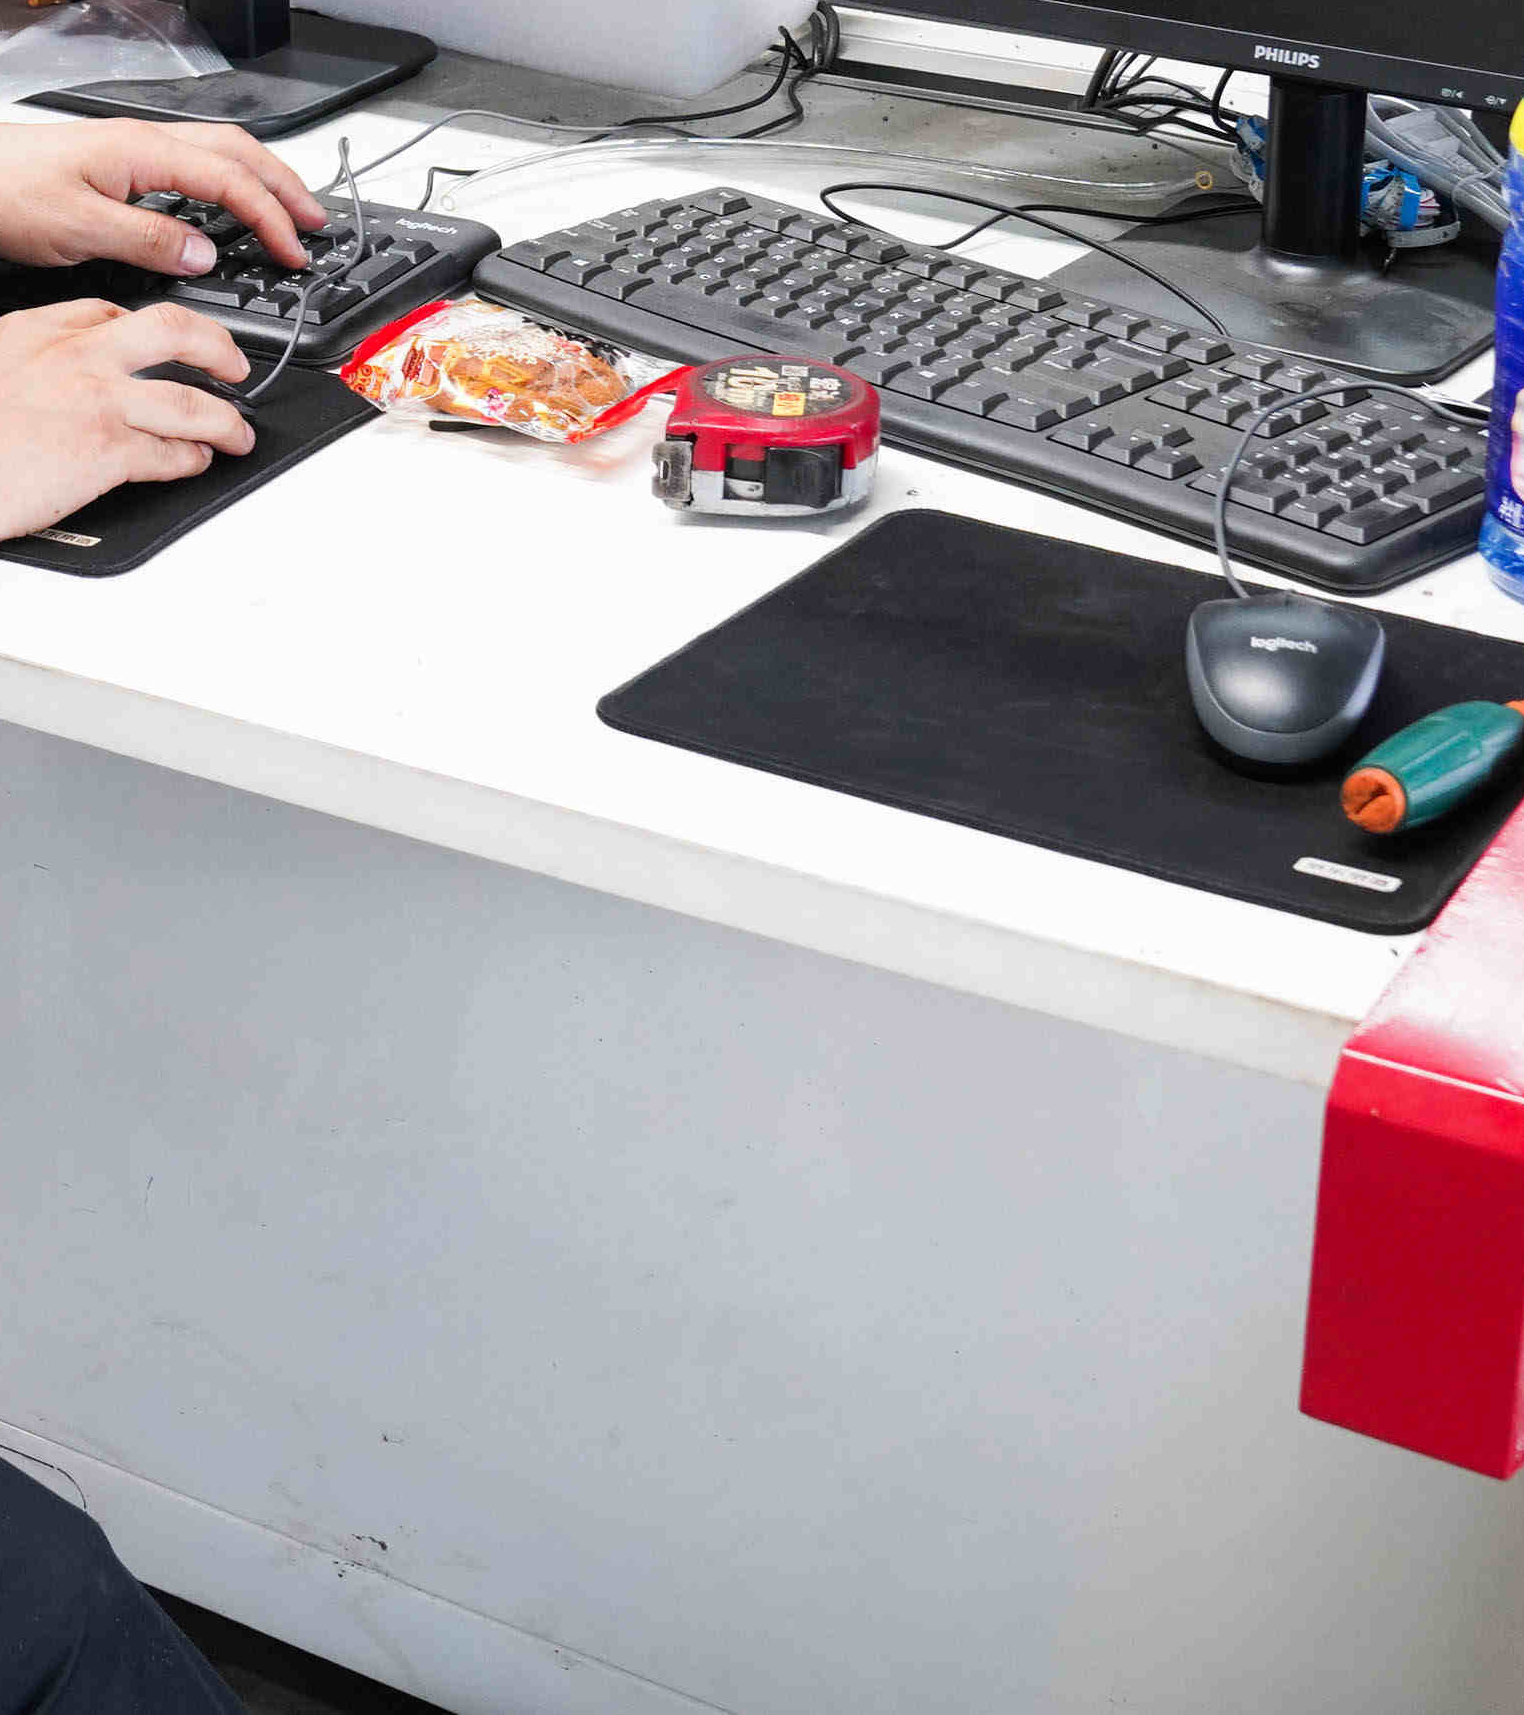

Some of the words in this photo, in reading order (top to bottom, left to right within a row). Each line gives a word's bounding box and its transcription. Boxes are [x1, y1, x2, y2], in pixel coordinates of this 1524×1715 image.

[1255, 45, 1320, 69] PHILIPS
[395, 217, 458, 236] logitech
[1250, 636, 1318, 654] logitech
